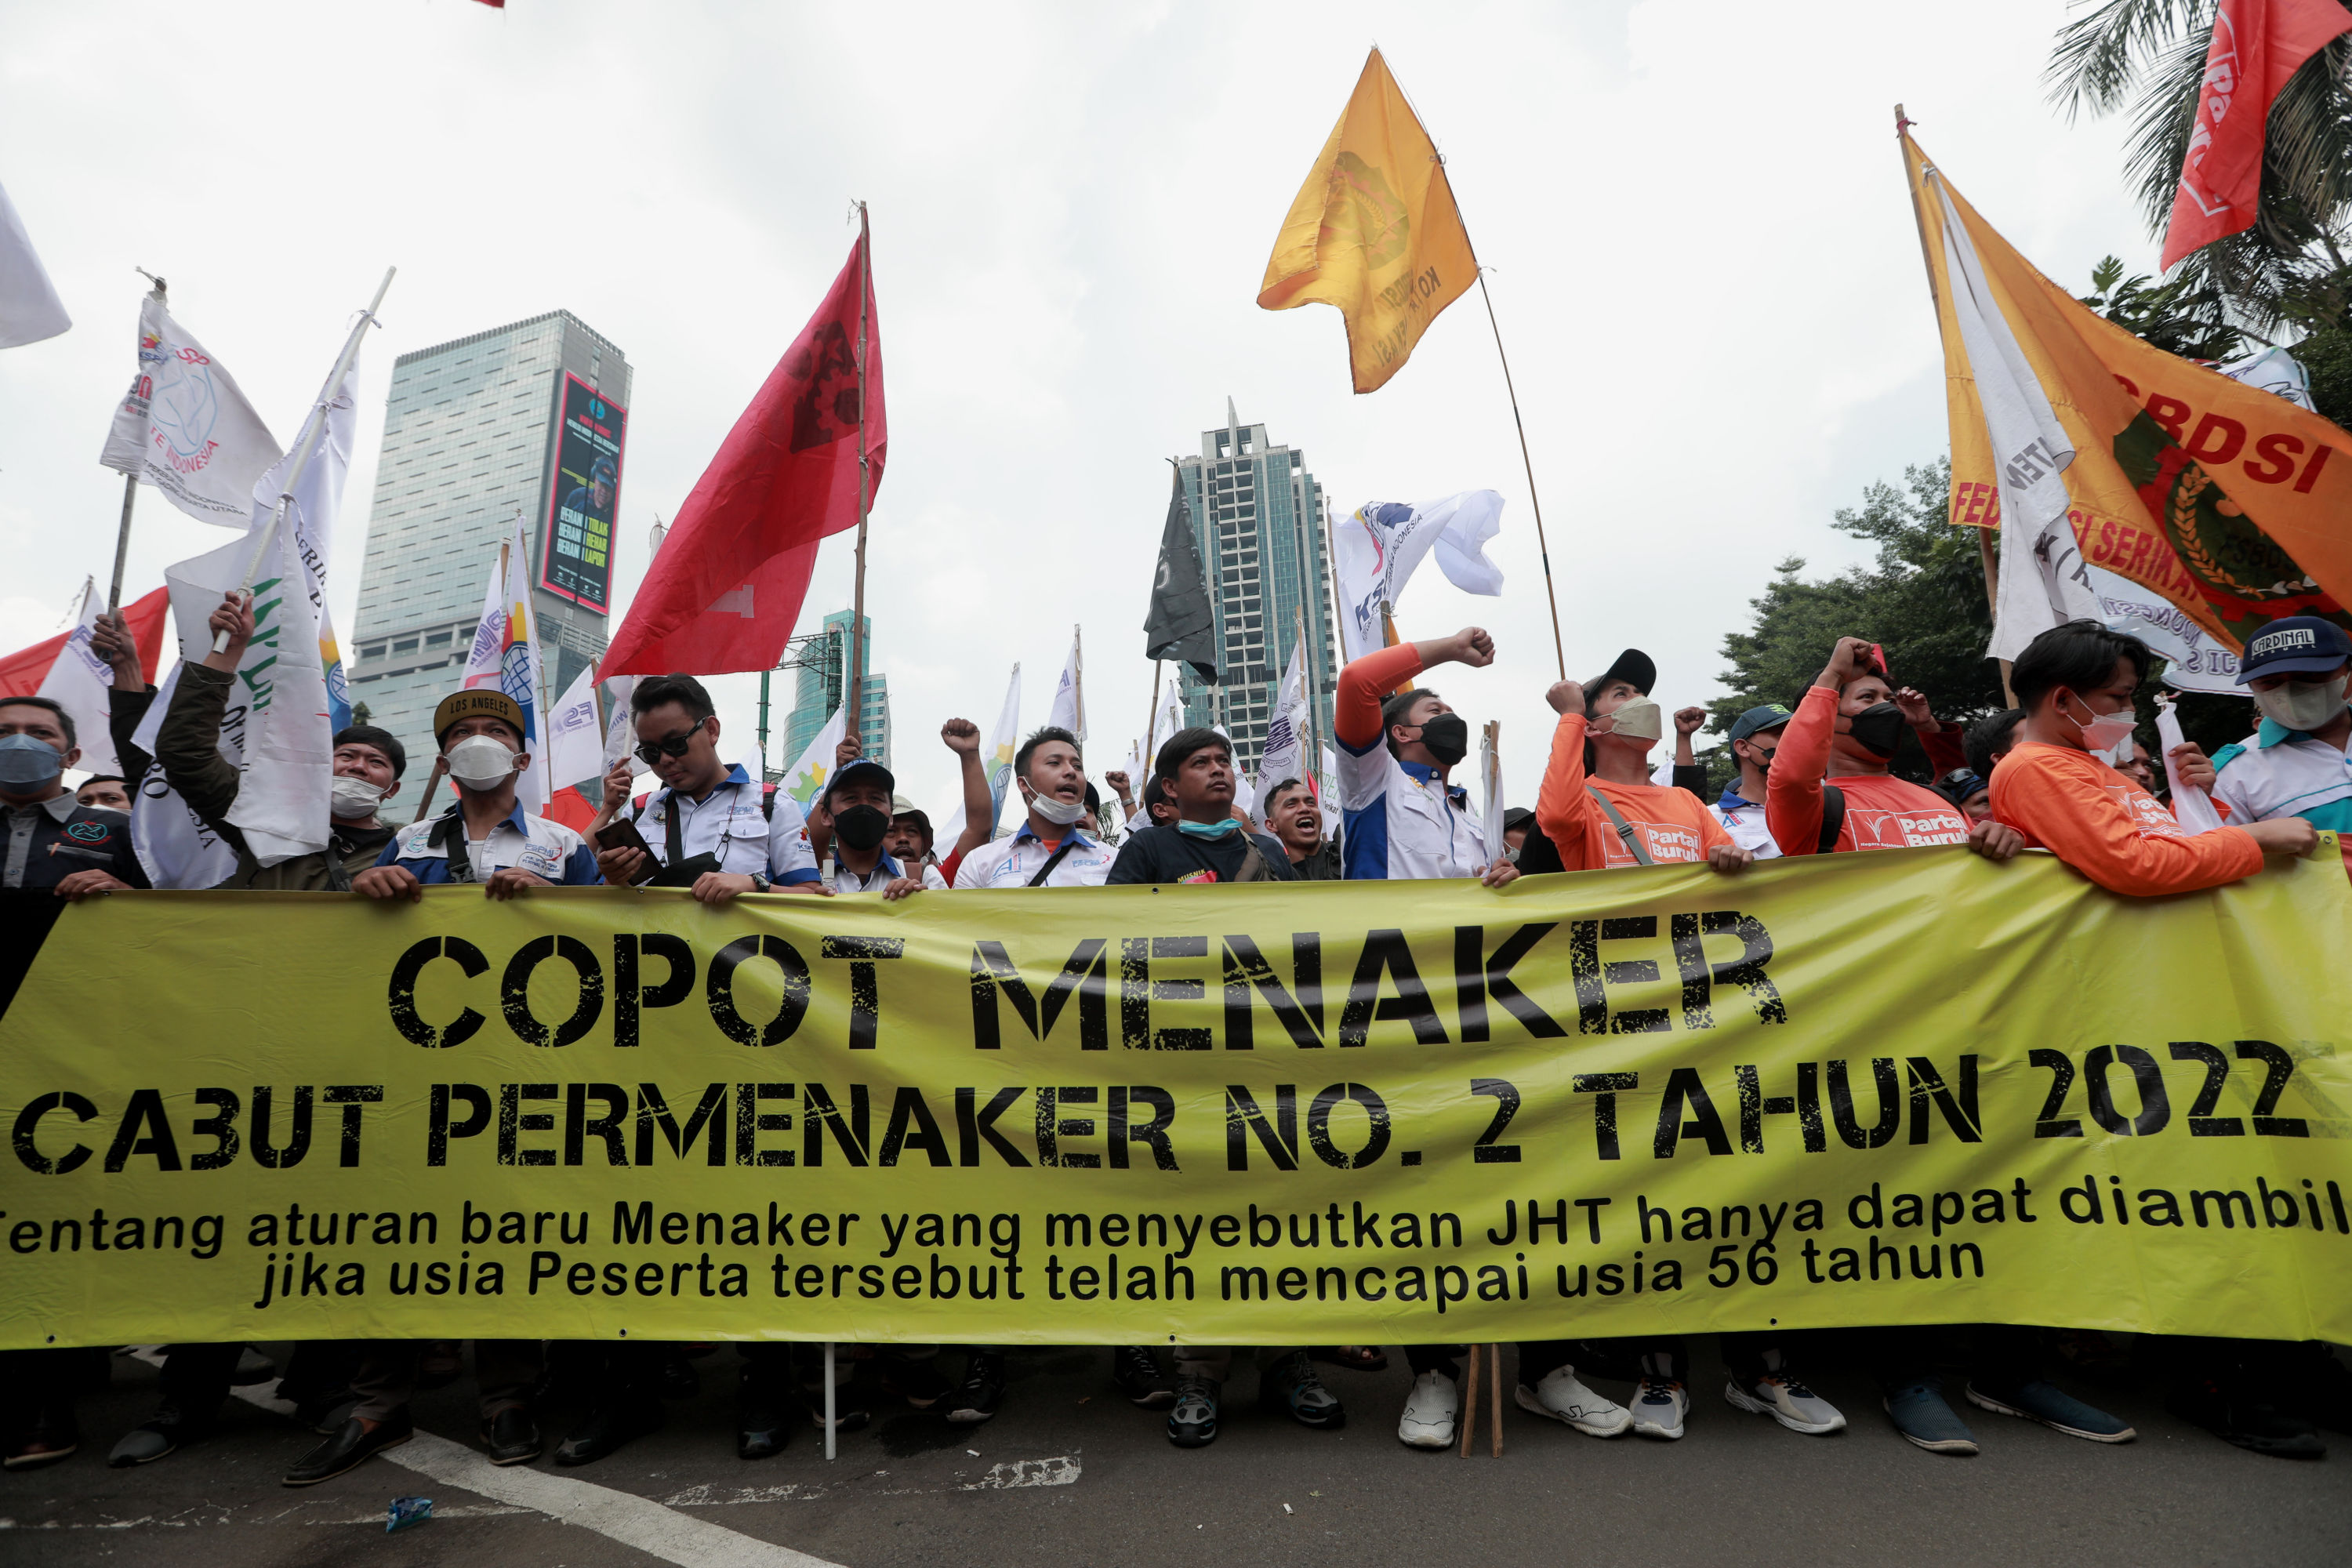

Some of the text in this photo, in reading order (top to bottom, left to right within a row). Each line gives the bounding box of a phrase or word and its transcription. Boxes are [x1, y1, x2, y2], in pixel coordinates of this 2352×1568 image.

[176, 347, 210, 365] SP
[165, 440, 219, 474] INDONESIA
[2252, 630, 2313, 653] CARDINAL
[450, 697, 509, 716] LOS ANGELES
[1899, 815, 1968, 833] Partai
[1648, 828, 1699, 850] Partai
[1651, 842, 1700, 862] Buruh
[388, 911, 1788, 1051] COPOT MENAKER
[427, 1083, 1181, 1174] PERMENAKER
[1226, 1082, 1423, 1172] NO.
[1471, 1079, 1521, 1163] 2
[1573, 1054, 1982, 1160] TAHUN
[2029, 1040, 2310, 1138] 2022
[0, 1175, 2350, 1258] entang aturan baru Menaker yang menyebutkan JHT hanya dapat diambil
[254, 1234, 1984, 1315] jika usia Peserta tersebut telah mencapai usia 56 tahun
